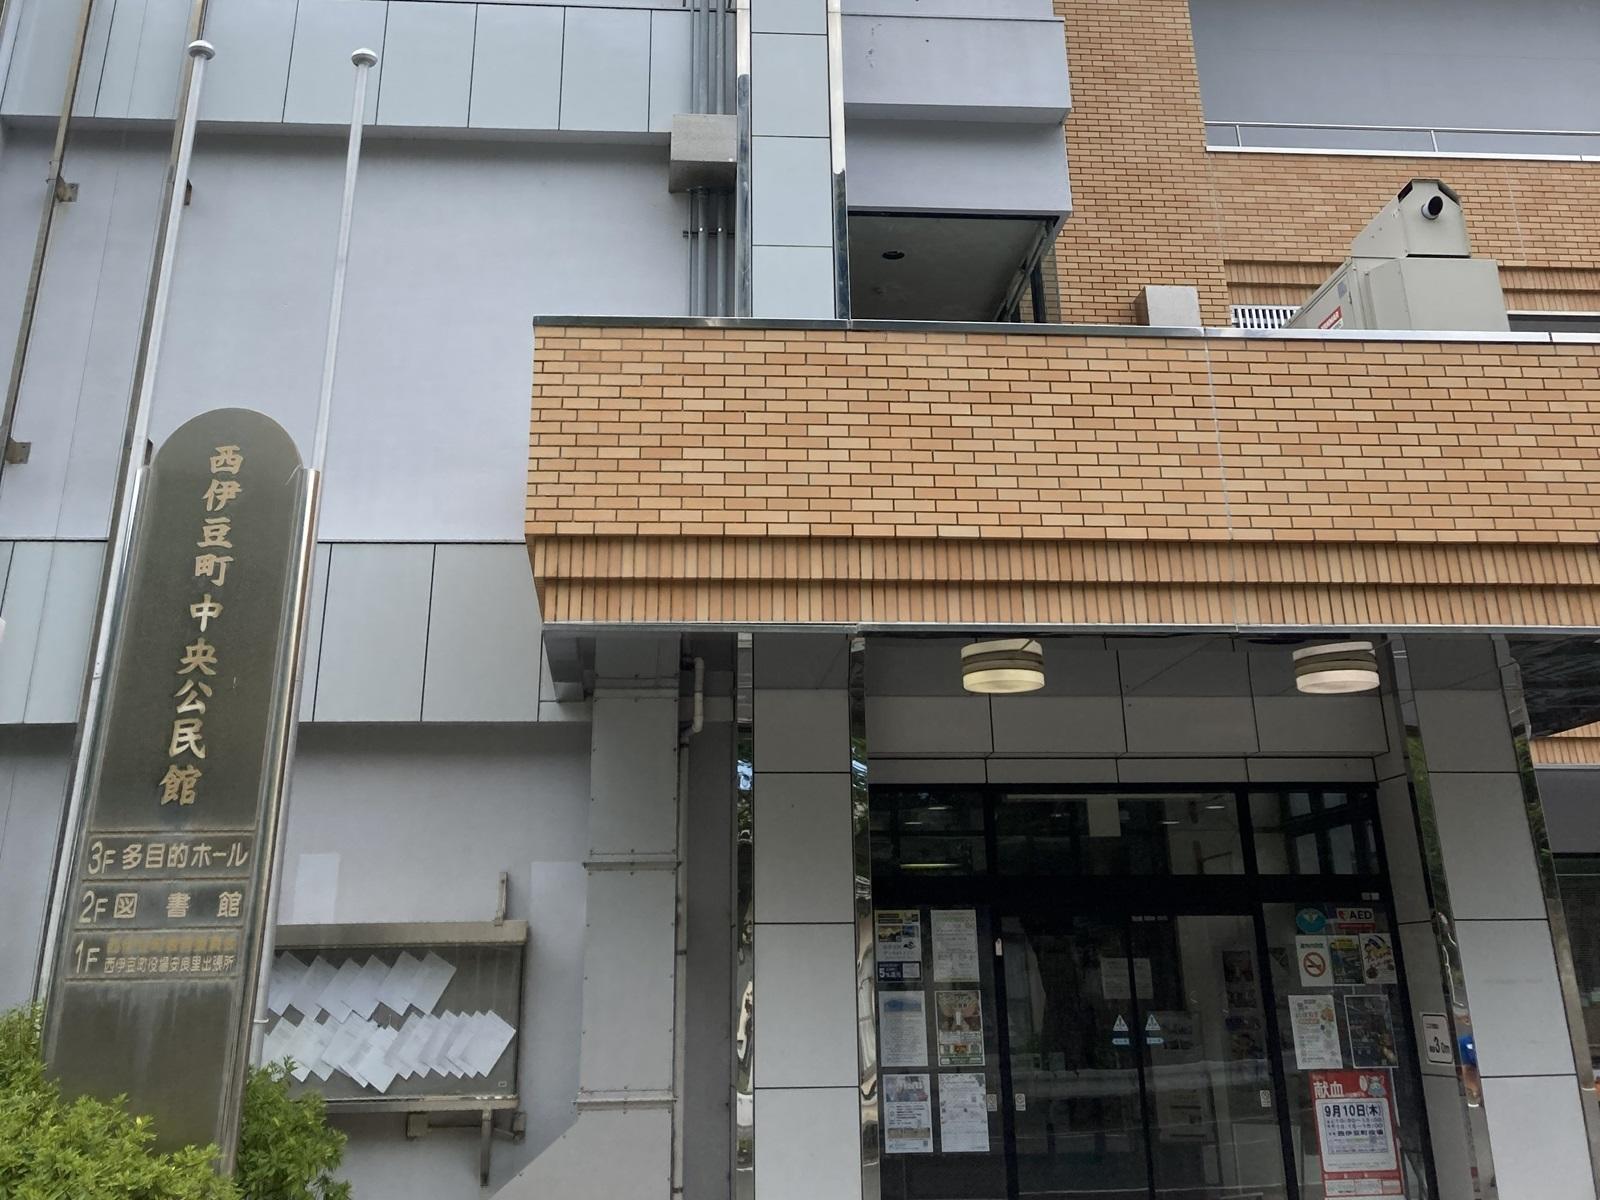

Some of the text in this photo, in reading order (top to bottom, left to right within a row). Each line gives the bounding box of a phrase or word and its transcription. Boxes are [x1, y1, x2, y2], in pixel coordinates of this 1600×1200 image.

[159, 445, 244, 807] 西伊豆町中央公民館
[88, 841, 248, 875] 3F 多目的ホール
[78, 890, 109, 924] 2F
[1349, 910, 1373, 920] AED
[75, 938, 100, 974] 1F
[1313, 1081, 1344, 1099] 献血
[1324, 1104, 1382, 1118] 9月10日(木)
